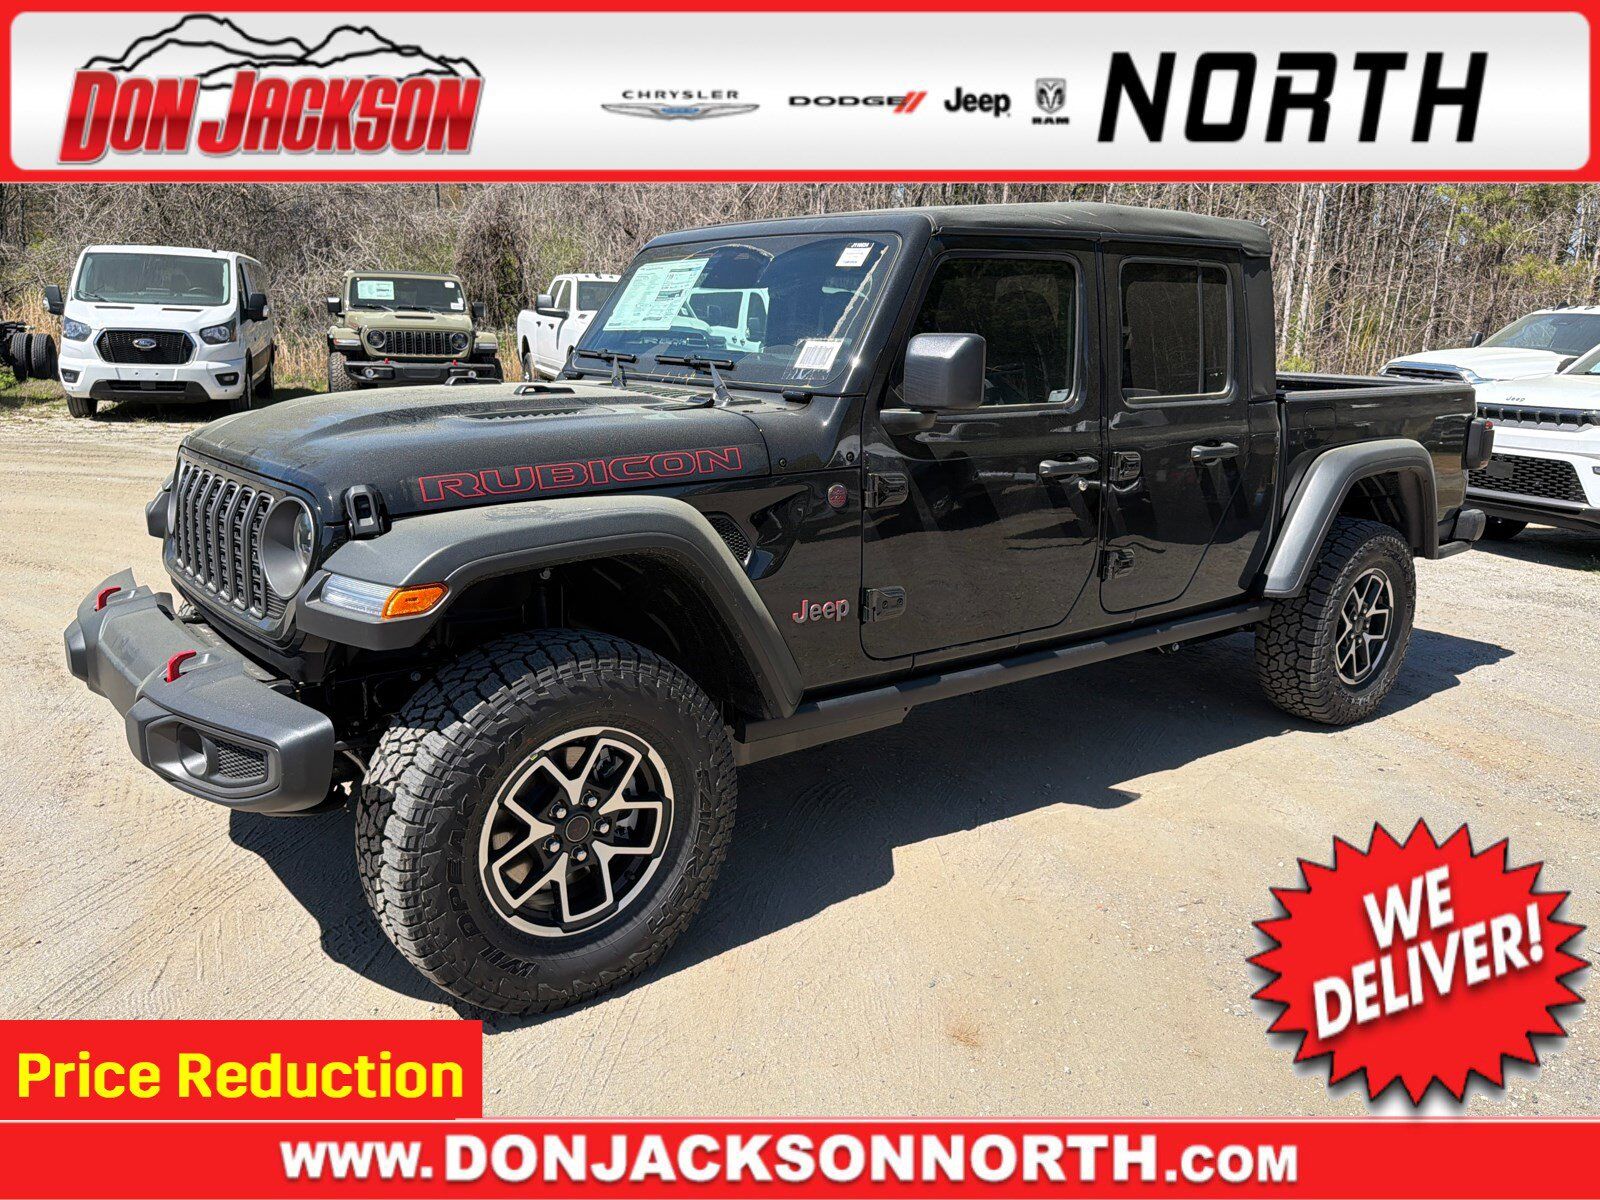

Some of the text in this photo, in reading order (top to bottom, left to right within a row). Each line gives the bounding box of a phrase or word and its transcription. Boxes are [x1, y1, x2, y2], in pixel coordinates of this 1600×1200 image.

[1505, 395, 1526, 403] Jeep
[418, 447, 742, 502] RUBICON
[792, 599, 850, 623] Jeep
